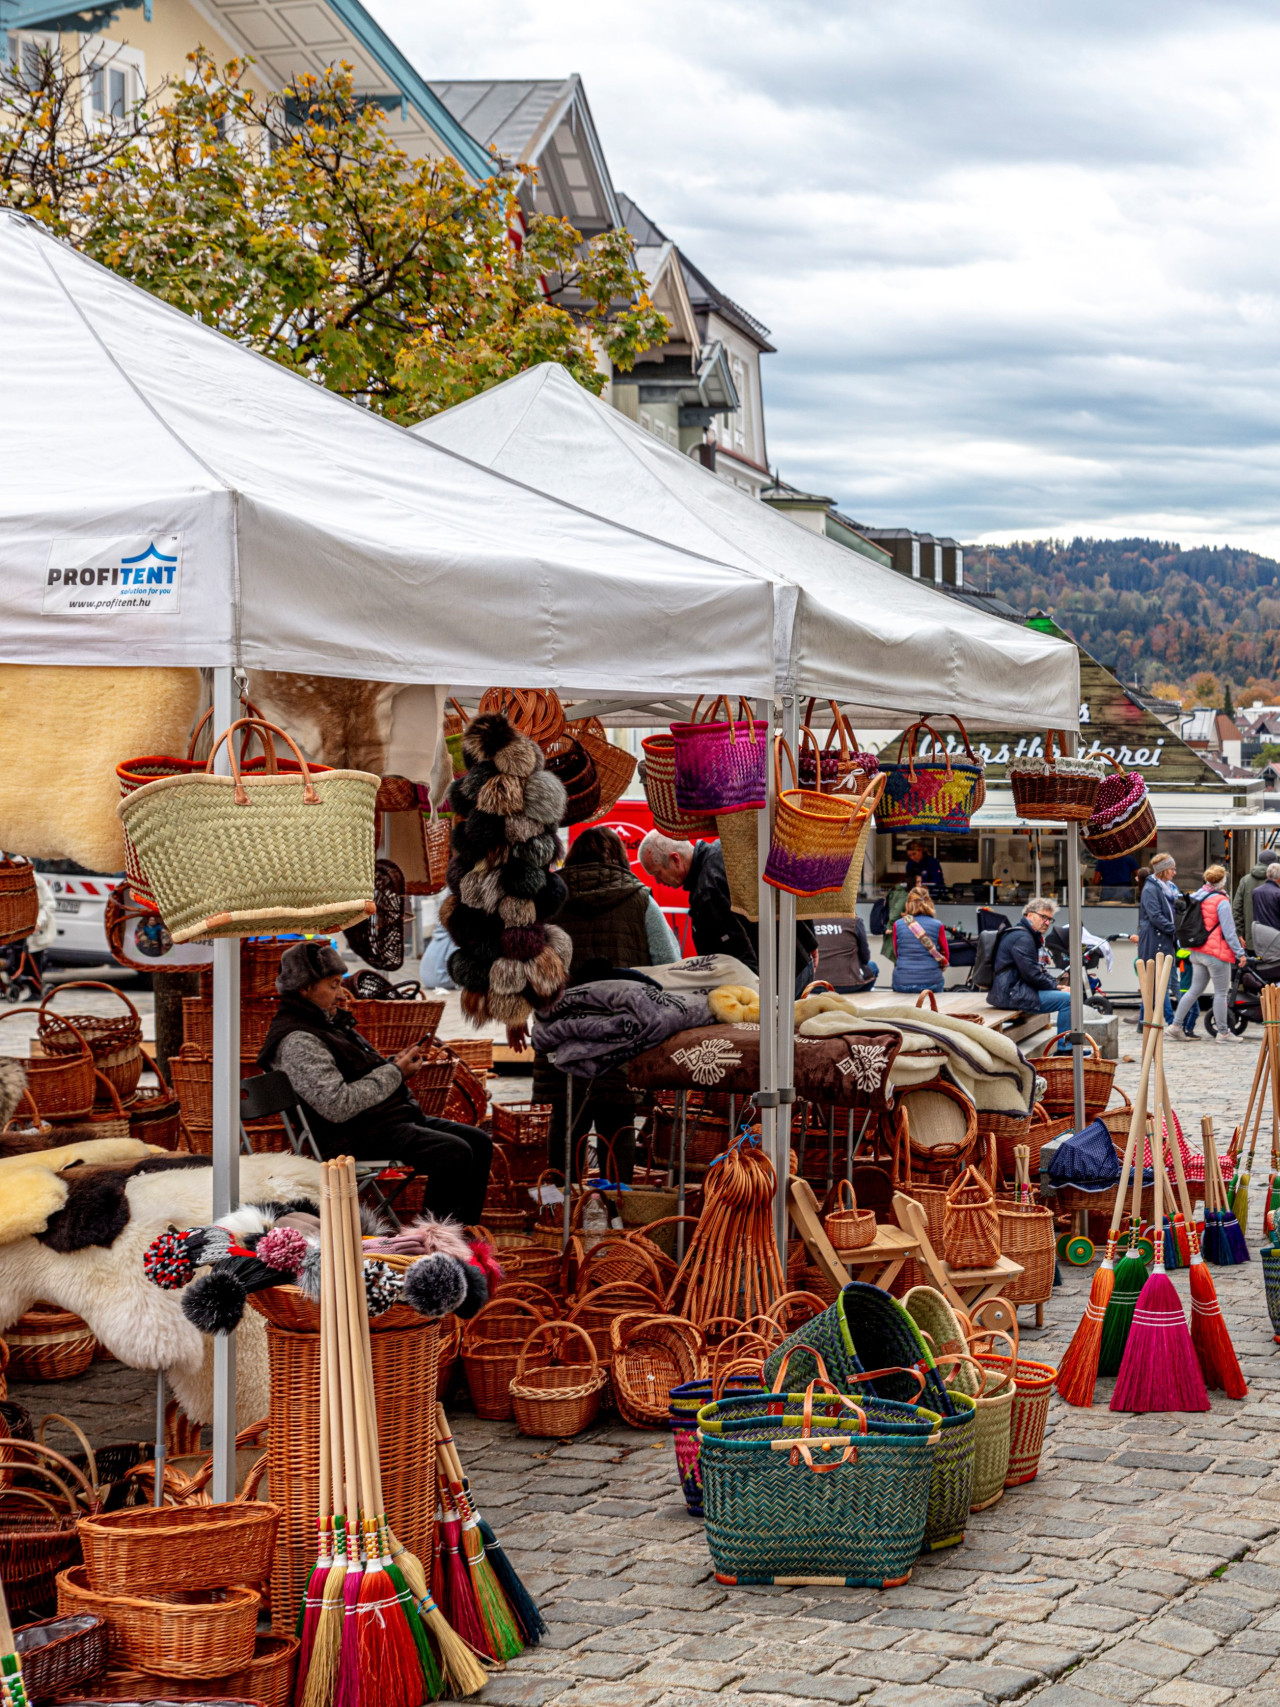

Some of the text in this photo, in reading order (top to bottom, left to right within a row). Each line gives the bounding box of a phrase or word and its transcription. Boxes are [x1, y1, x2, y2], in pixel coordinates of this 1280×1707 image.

[47, 566, 177, 586] PROFITENT
[148, 587, 159, 596] for
[159, 588, 171, 596] you
[69, 598, 151, 609] www.profitent.hu
